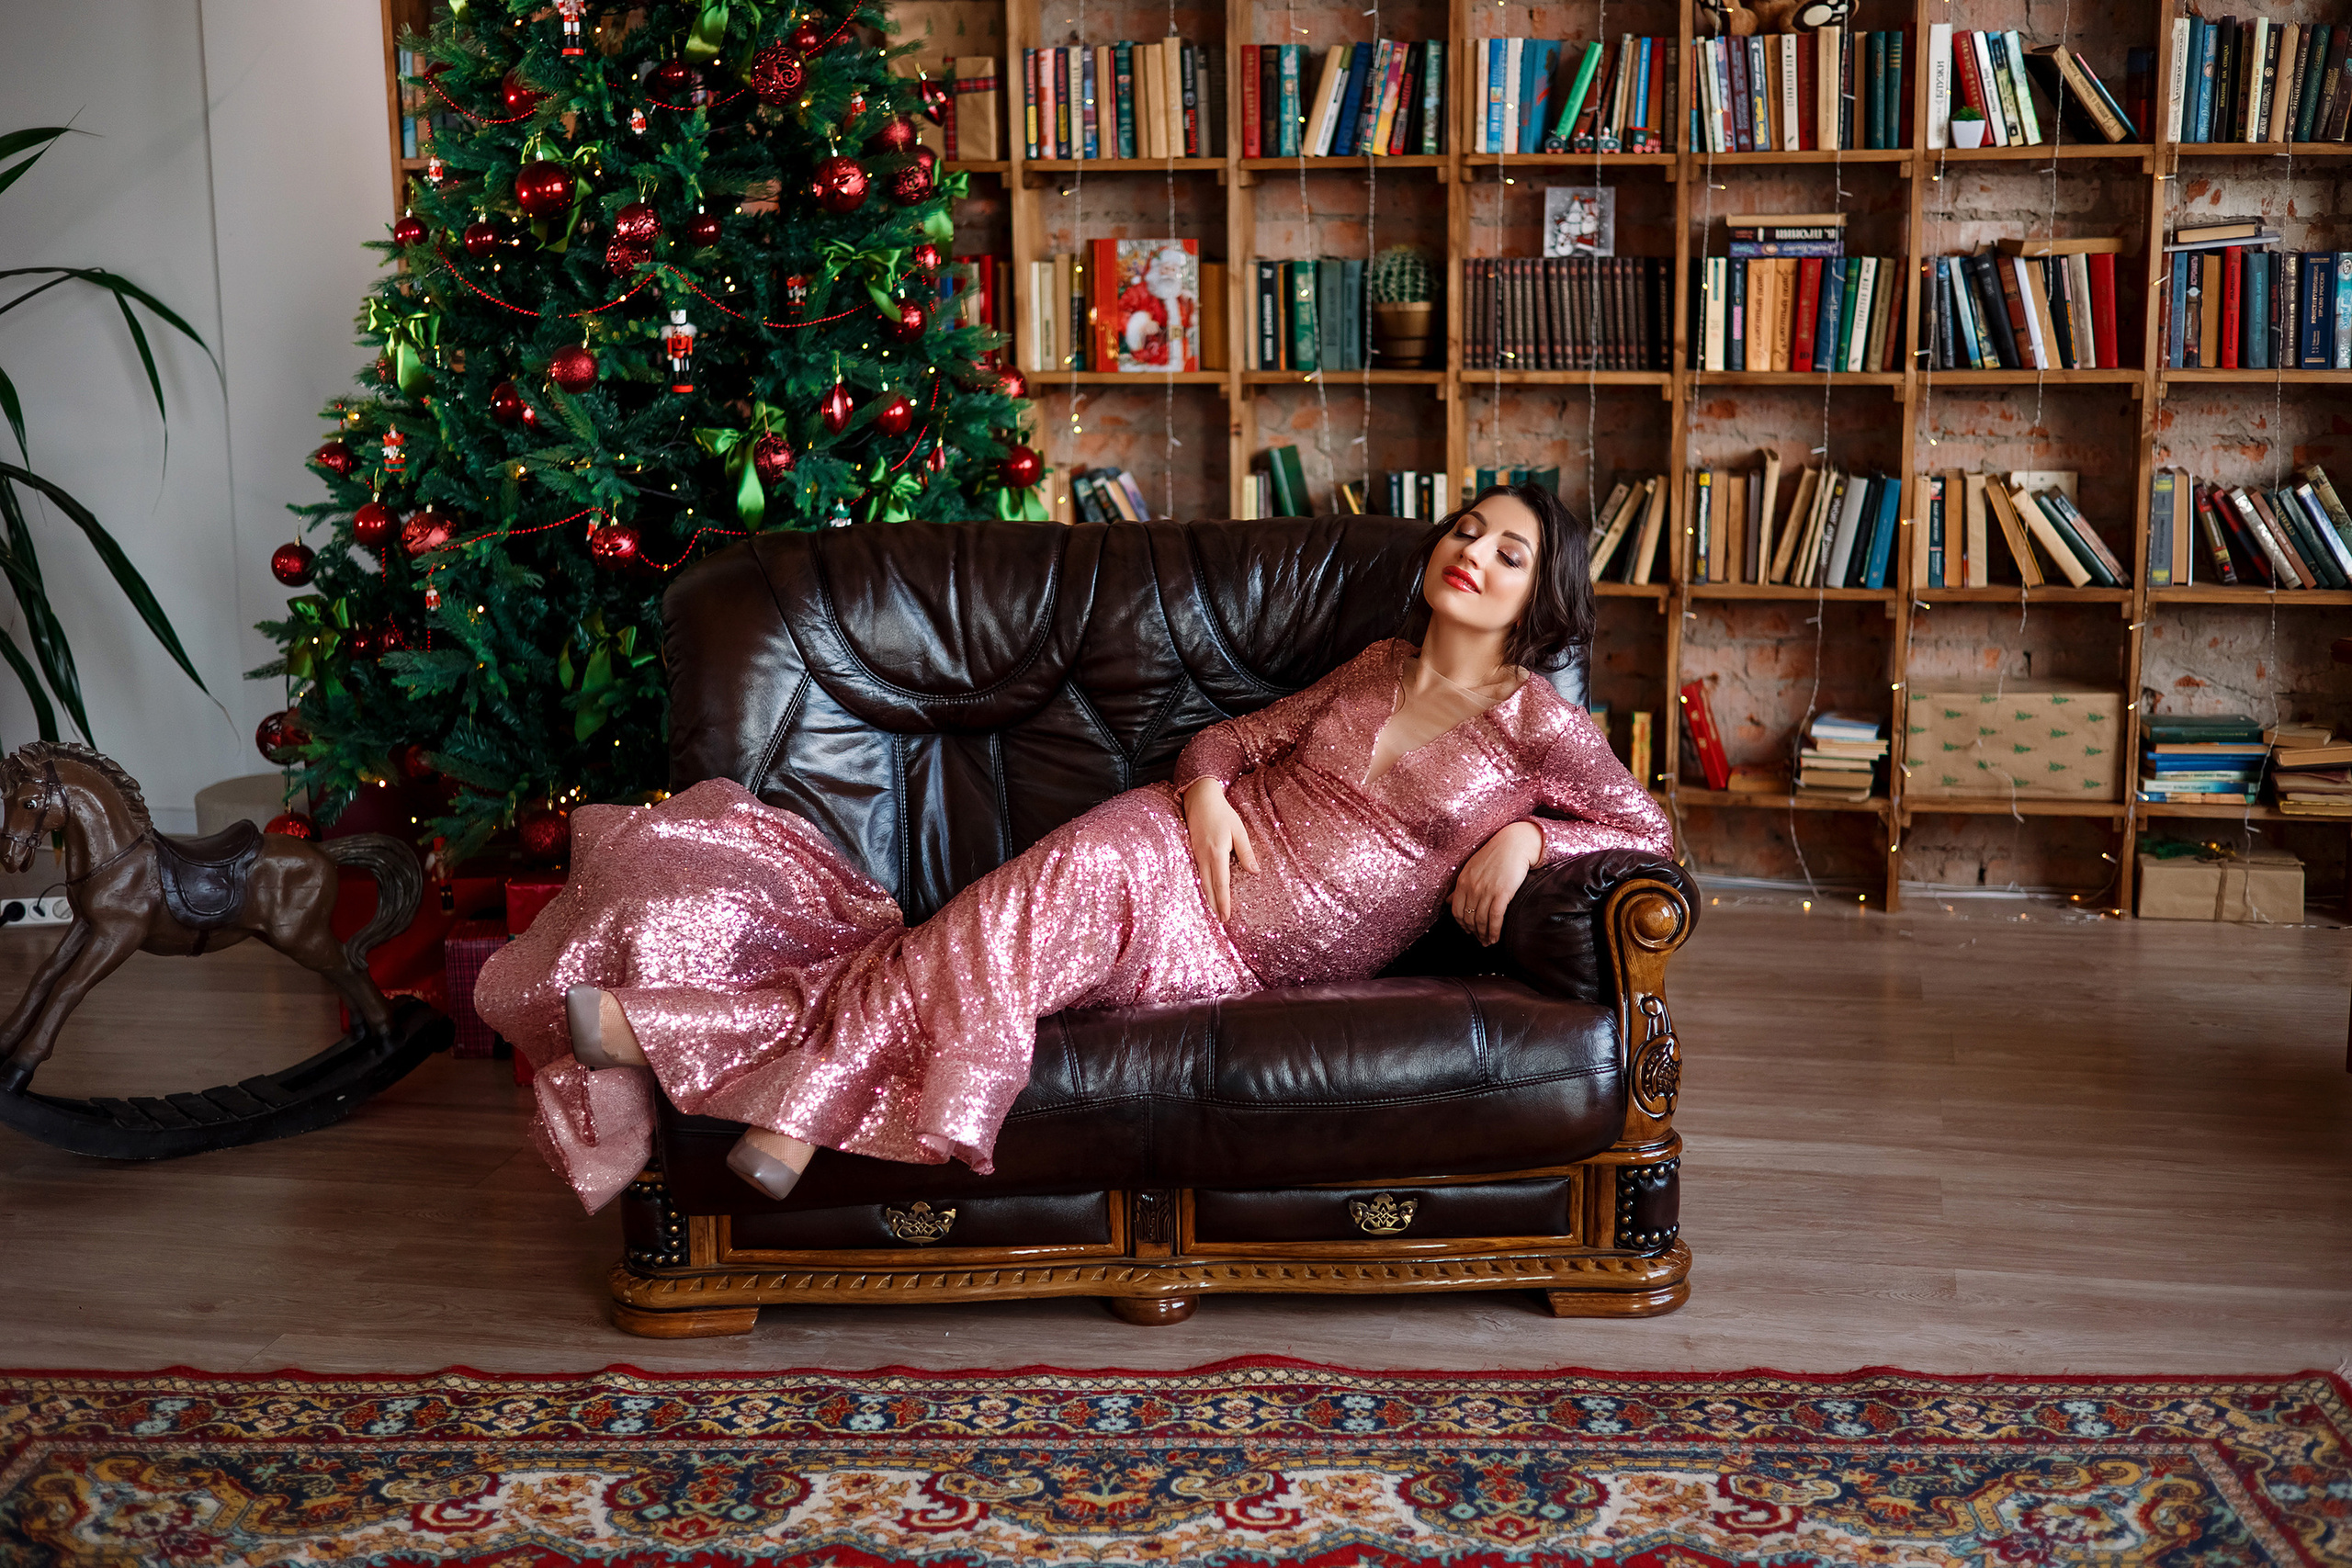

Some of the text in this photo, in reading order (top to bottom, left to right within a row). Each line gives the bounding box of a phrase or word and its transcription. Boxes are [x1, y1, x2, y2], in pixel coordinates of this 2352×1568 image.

[1936, 60, 1945, 98] БЛУЗКИ
[2222, 70, 2228, 79] НА
[2291, 47, 2307, 111] ЭНЦИКЛОПЕДИЯ
[2311, 265, 2320, 324] КОНСТИТУЦИОННОЕ
